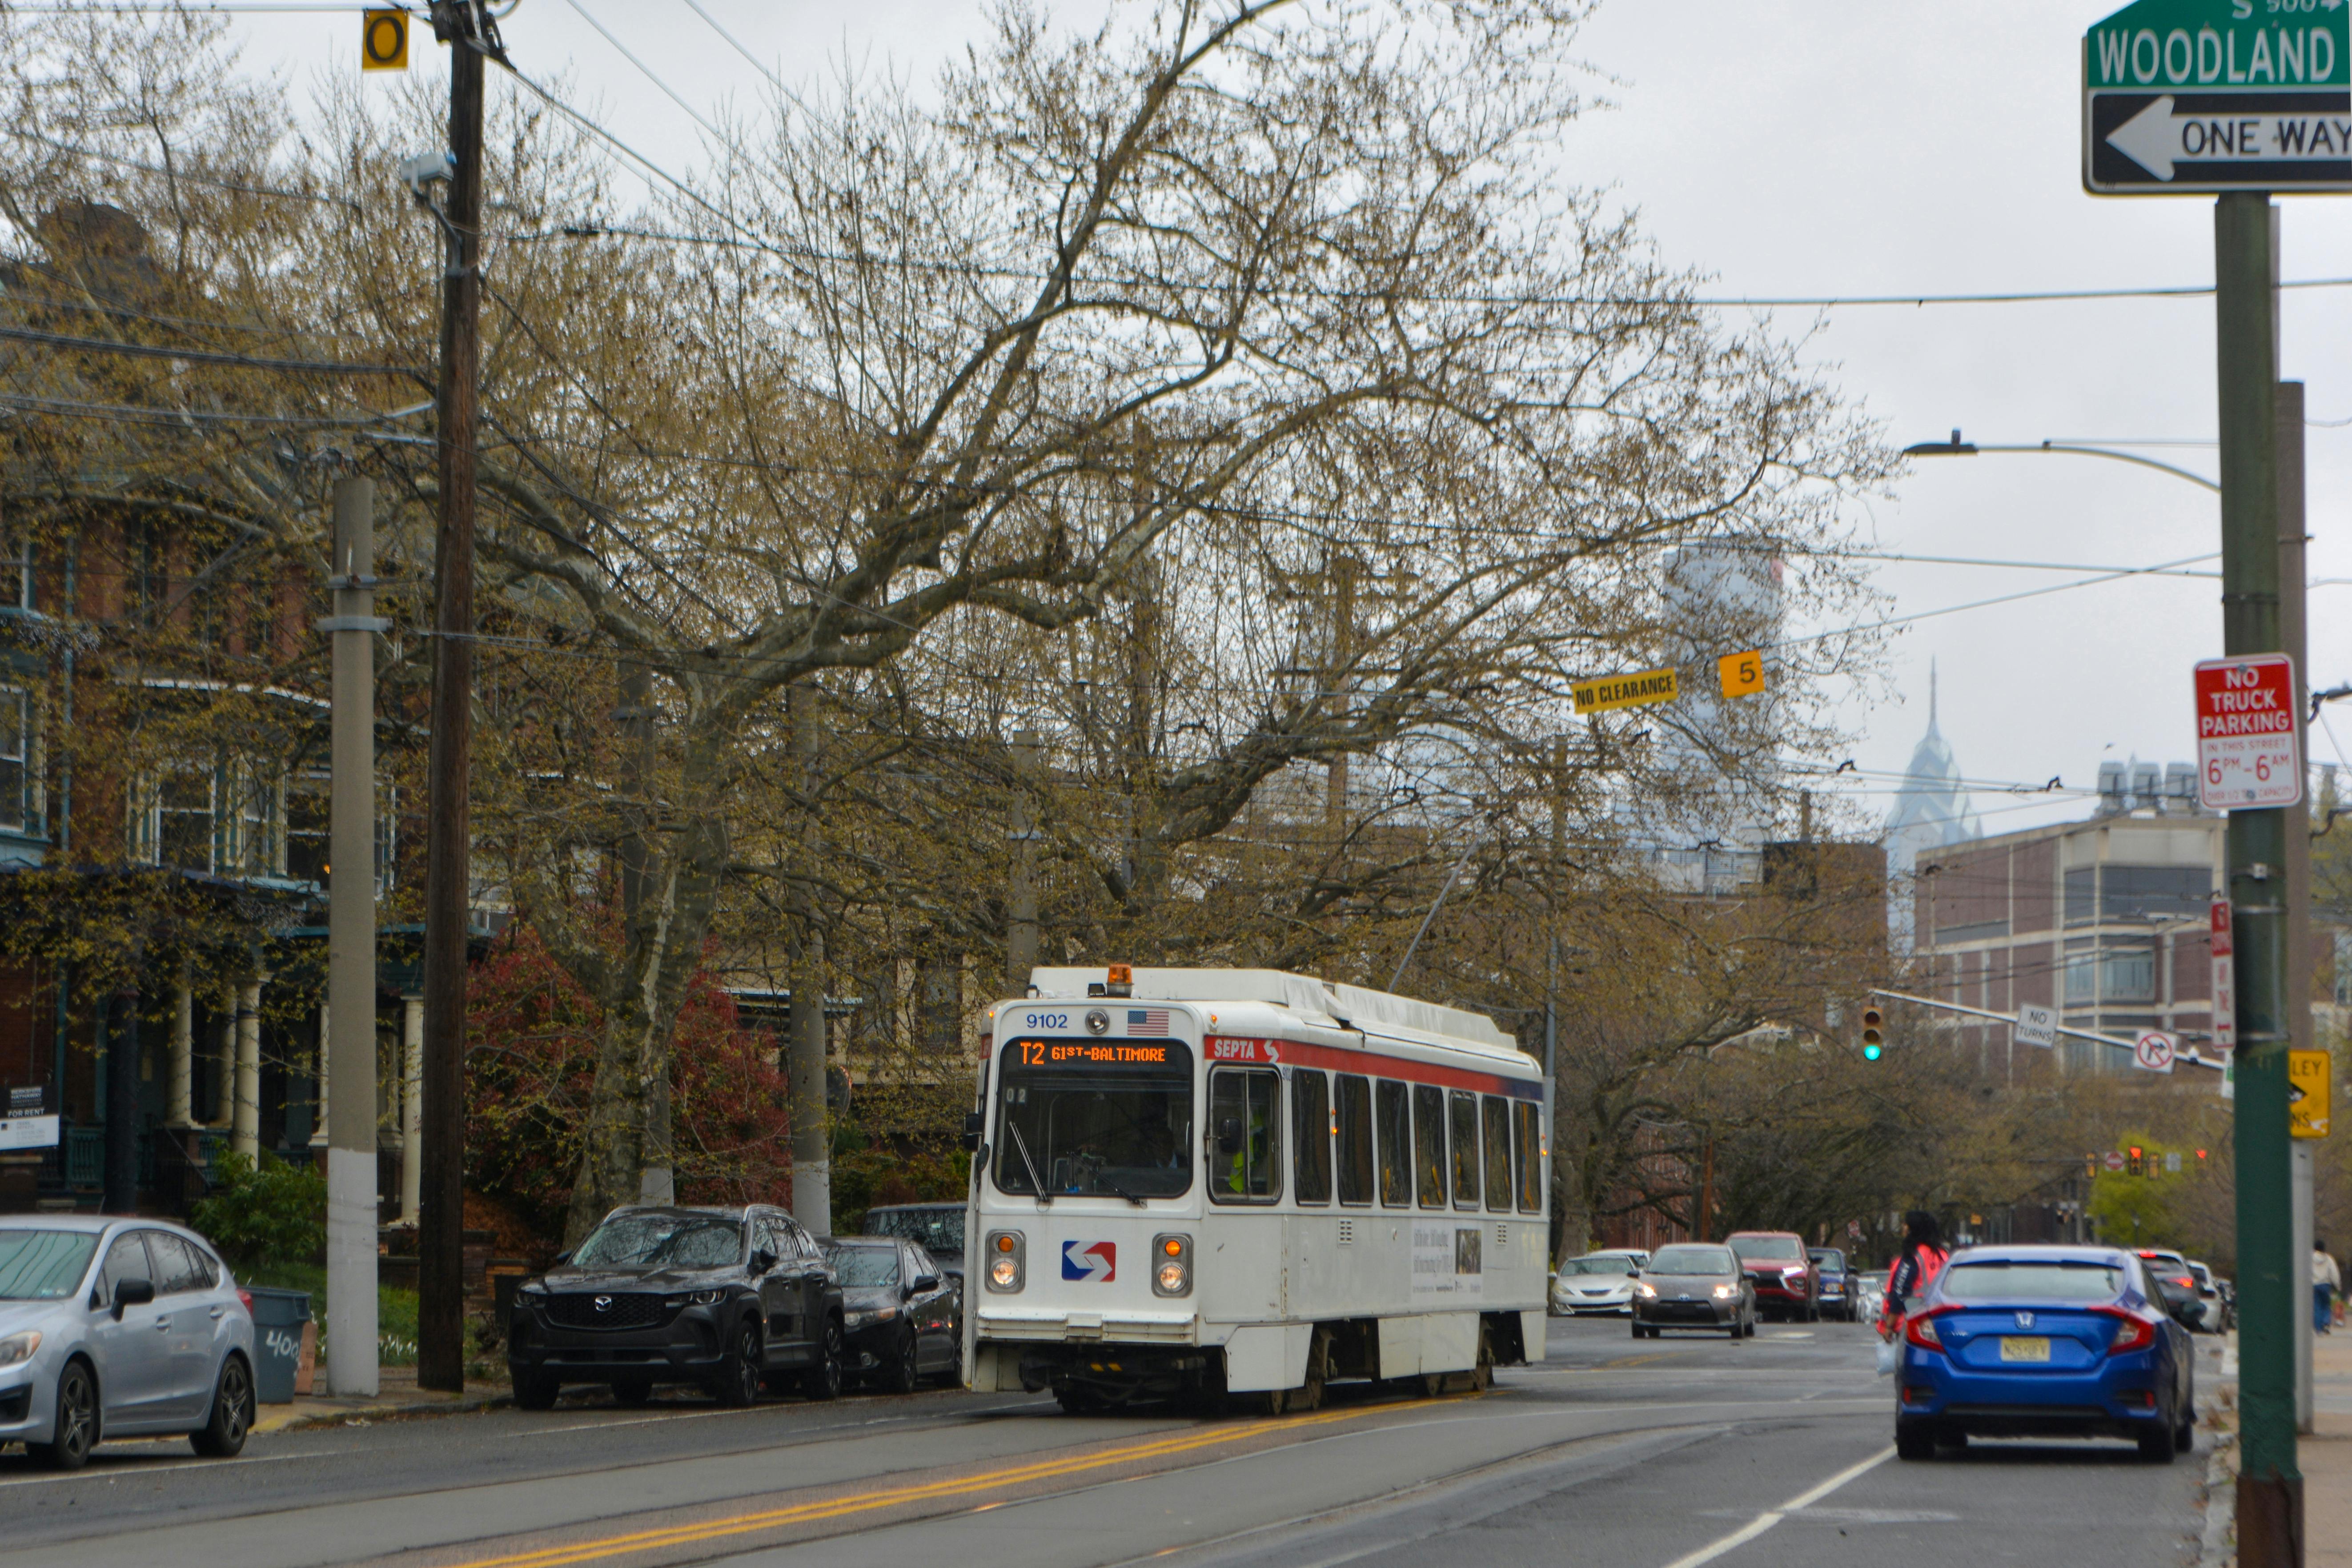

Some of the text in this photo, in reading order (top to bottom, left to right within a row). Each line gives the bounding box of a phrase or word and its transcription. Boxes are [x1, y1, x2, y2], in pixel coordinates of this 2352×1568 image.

[2232, 0, 2253, 19] S
[2097, 27, 2336, 84] WOODLAND
[2182, 118, 2351, 156] ONE WAY
[1739, 661, 1756, 684] 5
[2225, 668, 2259, 689] NO
[1575, 674, 1674, 707] NO CLEARANCE
[2210, 688, 2278, 712] TRUCK
[2202, 711, 2289, 736] PARKING
[2222, 740, 2245, 752] THIS
[2249, 737, 2286, 751] STREET
[1027, 1014, 1068, 1029] 9102
[2029, 1010, 2047, 1024] NO
[2019, 1025, 2052, 1042] TURNS
[1021, 1042, 1045, 1065] T2
[1214, 1039, 1255, 1059] SEPTA
[2292, 1060, 2322, 1076] LEY
